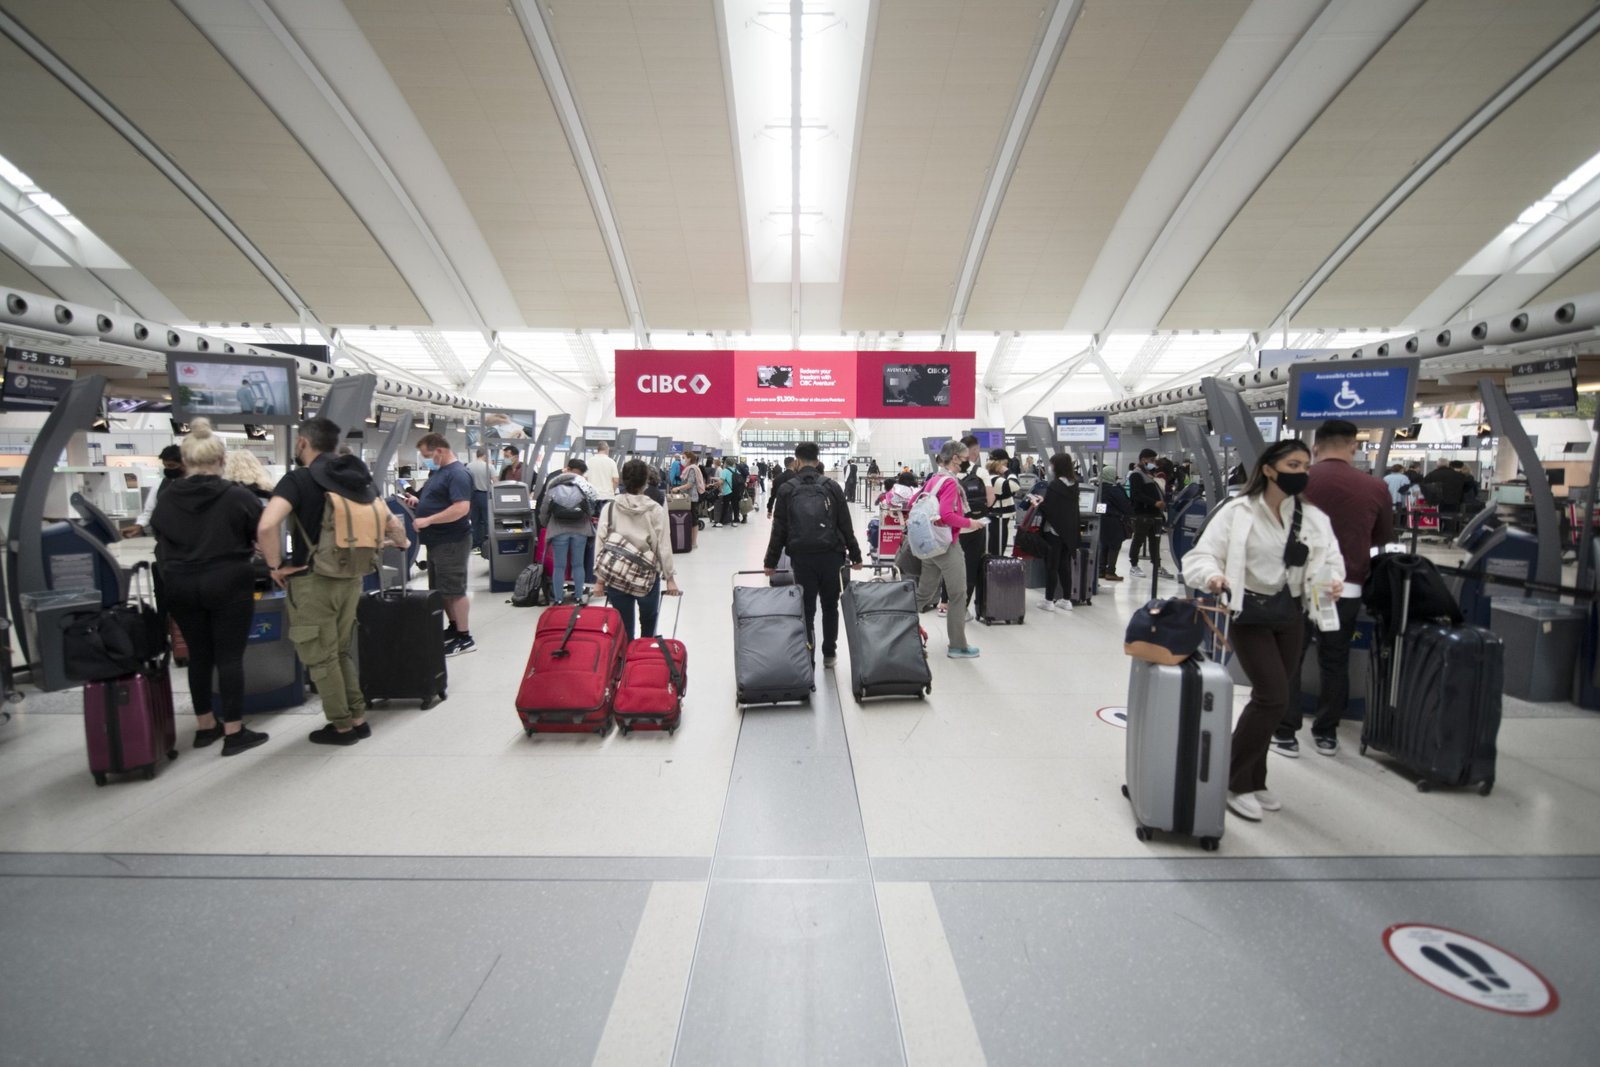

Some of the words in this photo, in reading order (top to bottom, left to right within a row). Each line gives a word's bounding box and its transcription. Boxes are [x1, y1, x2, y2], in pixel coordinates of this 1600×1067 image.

[21, 351, 38, 361] 5-5
[49, 356, 65, 365] 5-6
[1518, 365, 1533, 374] 4-6
[1544, 361, 1560, 370] 4-5
[637, 374, 688, 394] CIBC
